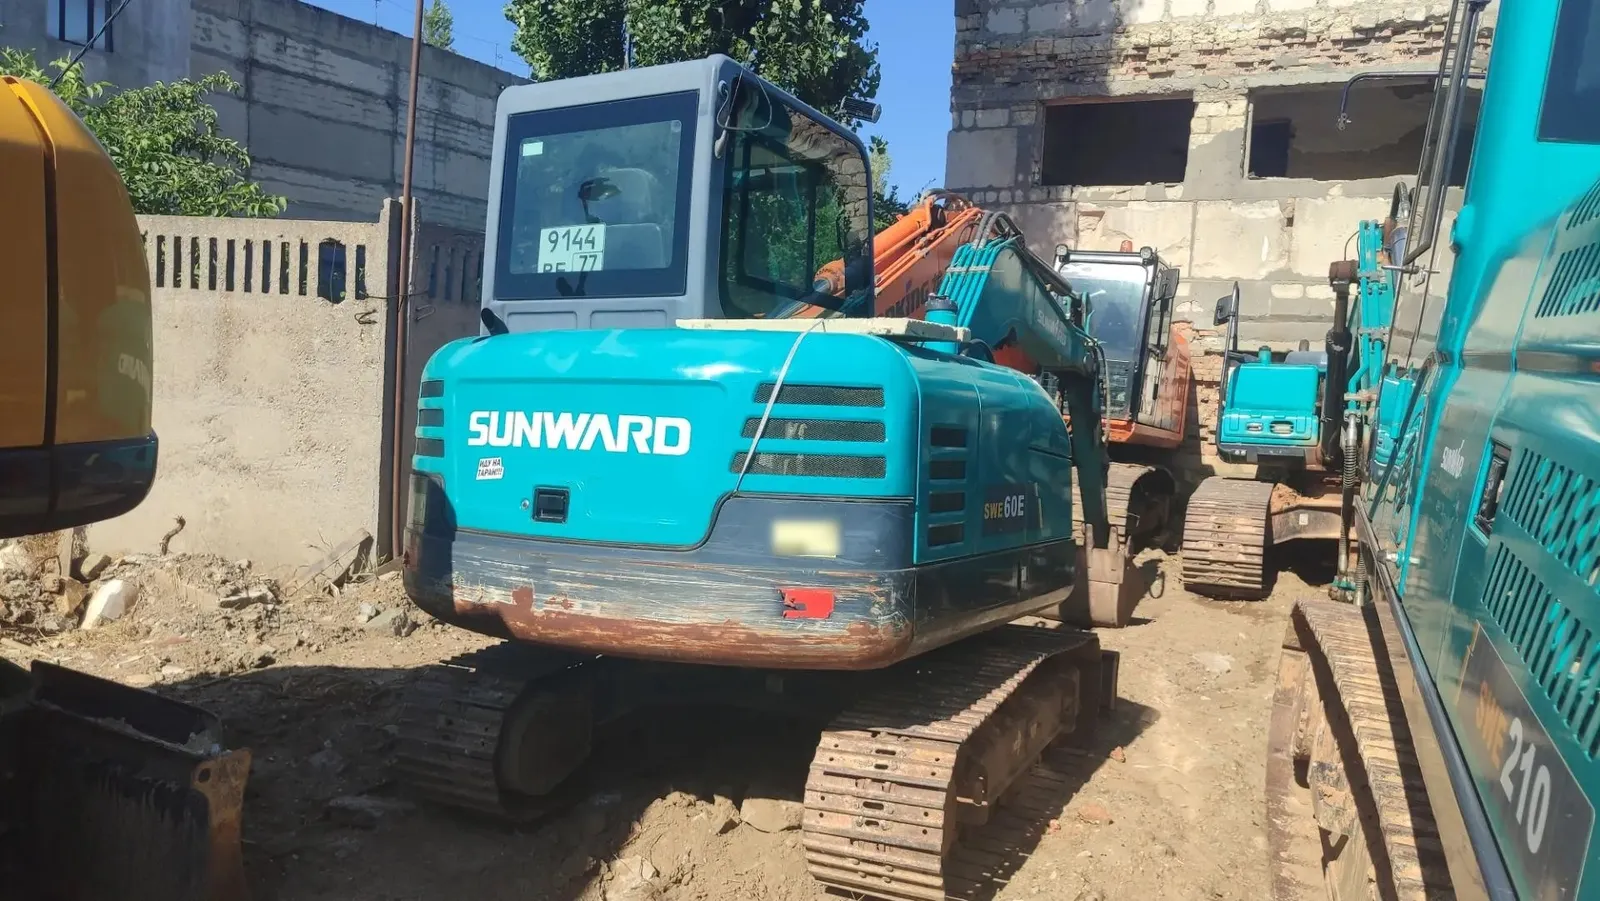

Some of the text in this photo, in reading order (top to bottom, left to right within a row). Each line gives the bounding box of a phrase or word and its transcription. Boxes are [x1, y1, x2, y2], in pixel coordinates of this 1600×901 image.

[548, 227, 596, 252] 9144
[579, 254, 597, 272] 77
[467, 410, 692, 456] SUNWARD
[479, 458, 501, 468] ИДУ НА
